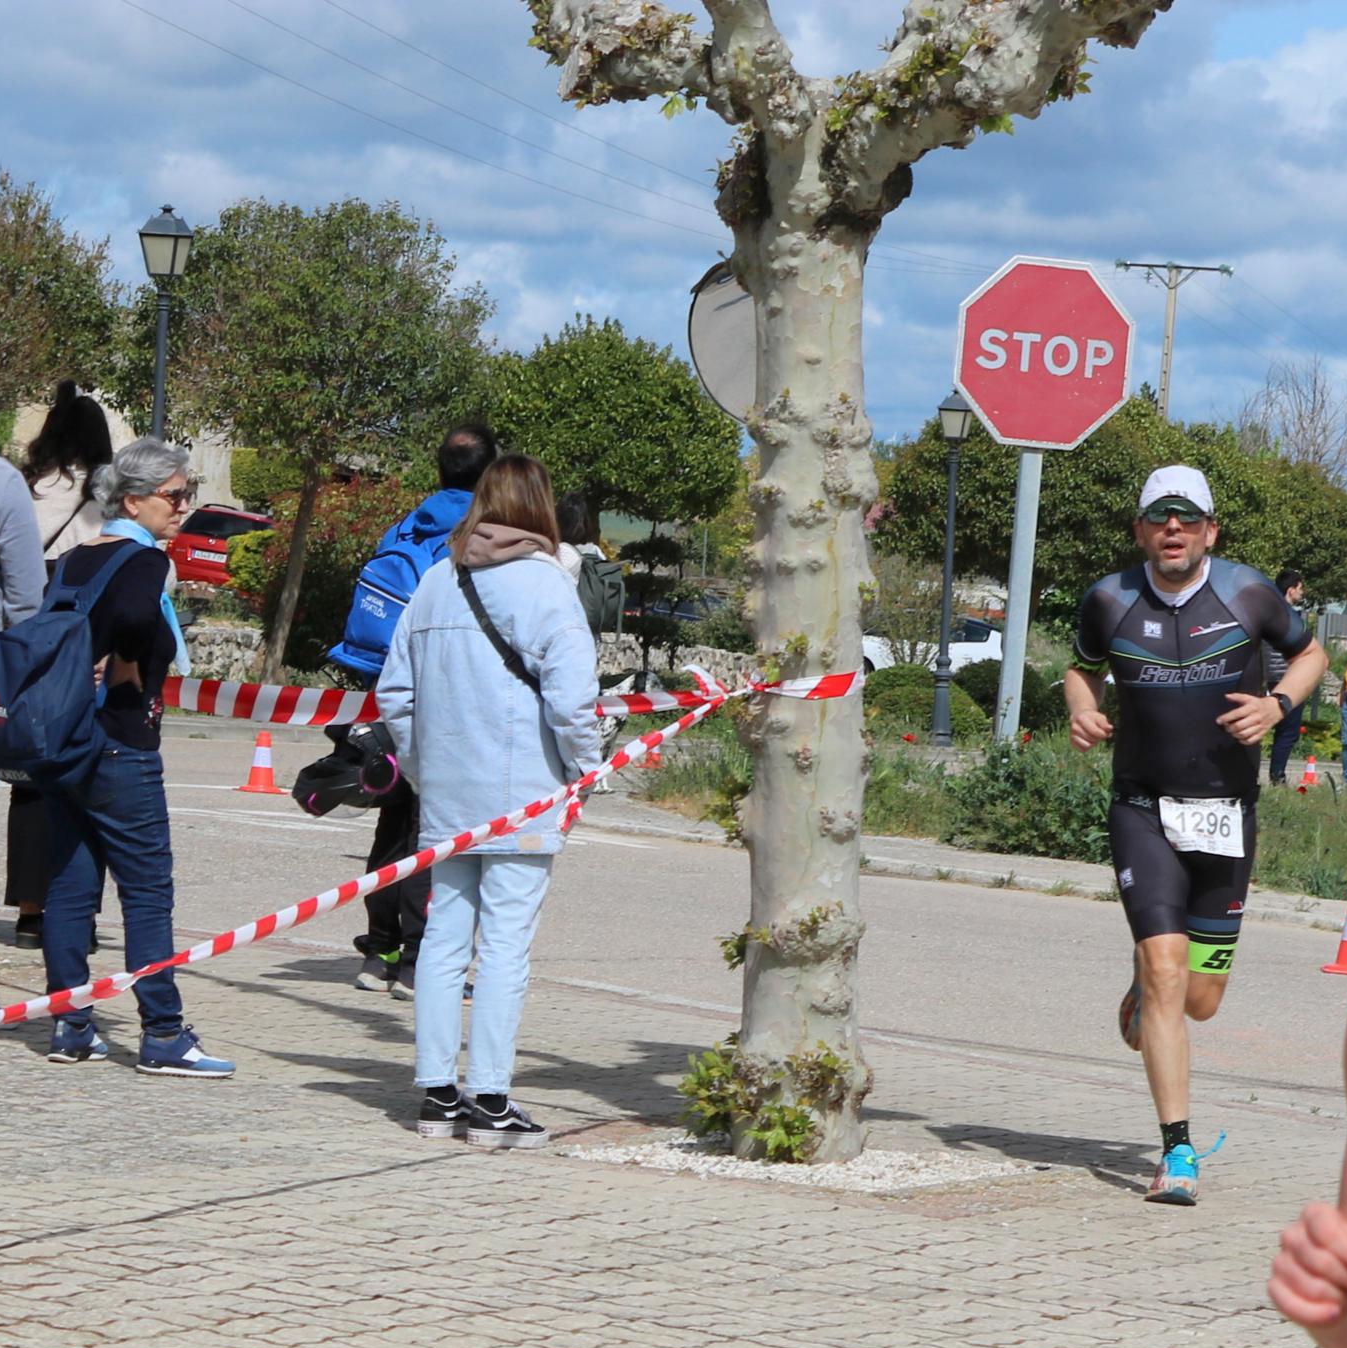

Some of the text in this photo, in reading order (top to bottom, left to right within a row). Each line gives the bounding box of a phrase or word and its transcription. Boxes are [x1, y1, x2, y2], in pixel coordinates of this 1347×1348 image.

[975, 328, 1115, 379] STOP
[1139, 659, 1227, 683] Santini
[1175, 811, 1232, 838] 1296
